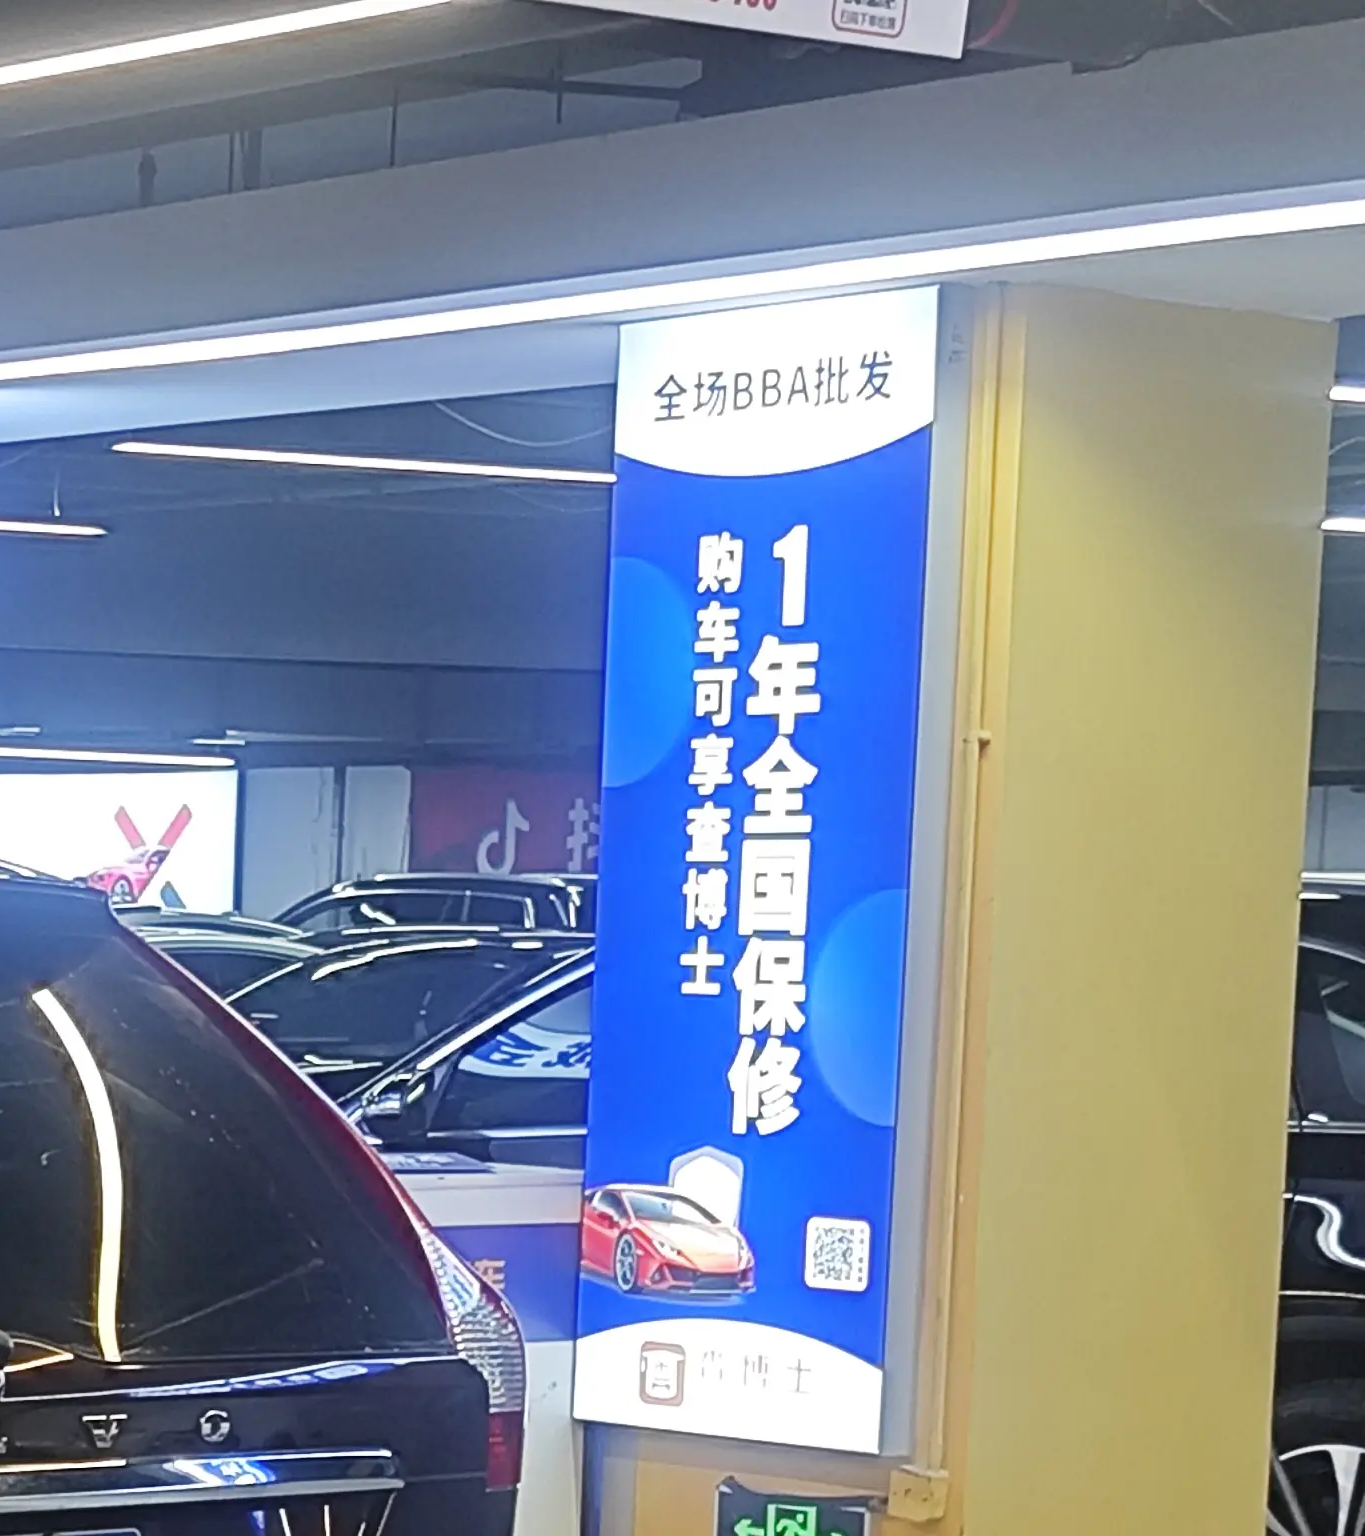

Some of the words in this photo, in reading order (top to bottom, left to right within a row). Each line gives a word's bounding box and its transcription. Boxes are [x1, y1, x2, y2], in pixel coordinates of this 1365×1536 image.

[654, 350, 893, 422] 全场BBA批发
[678, 530, 744, 998] 购车可享查博士
[727, 523, 822, 1137] 1年全国保修
